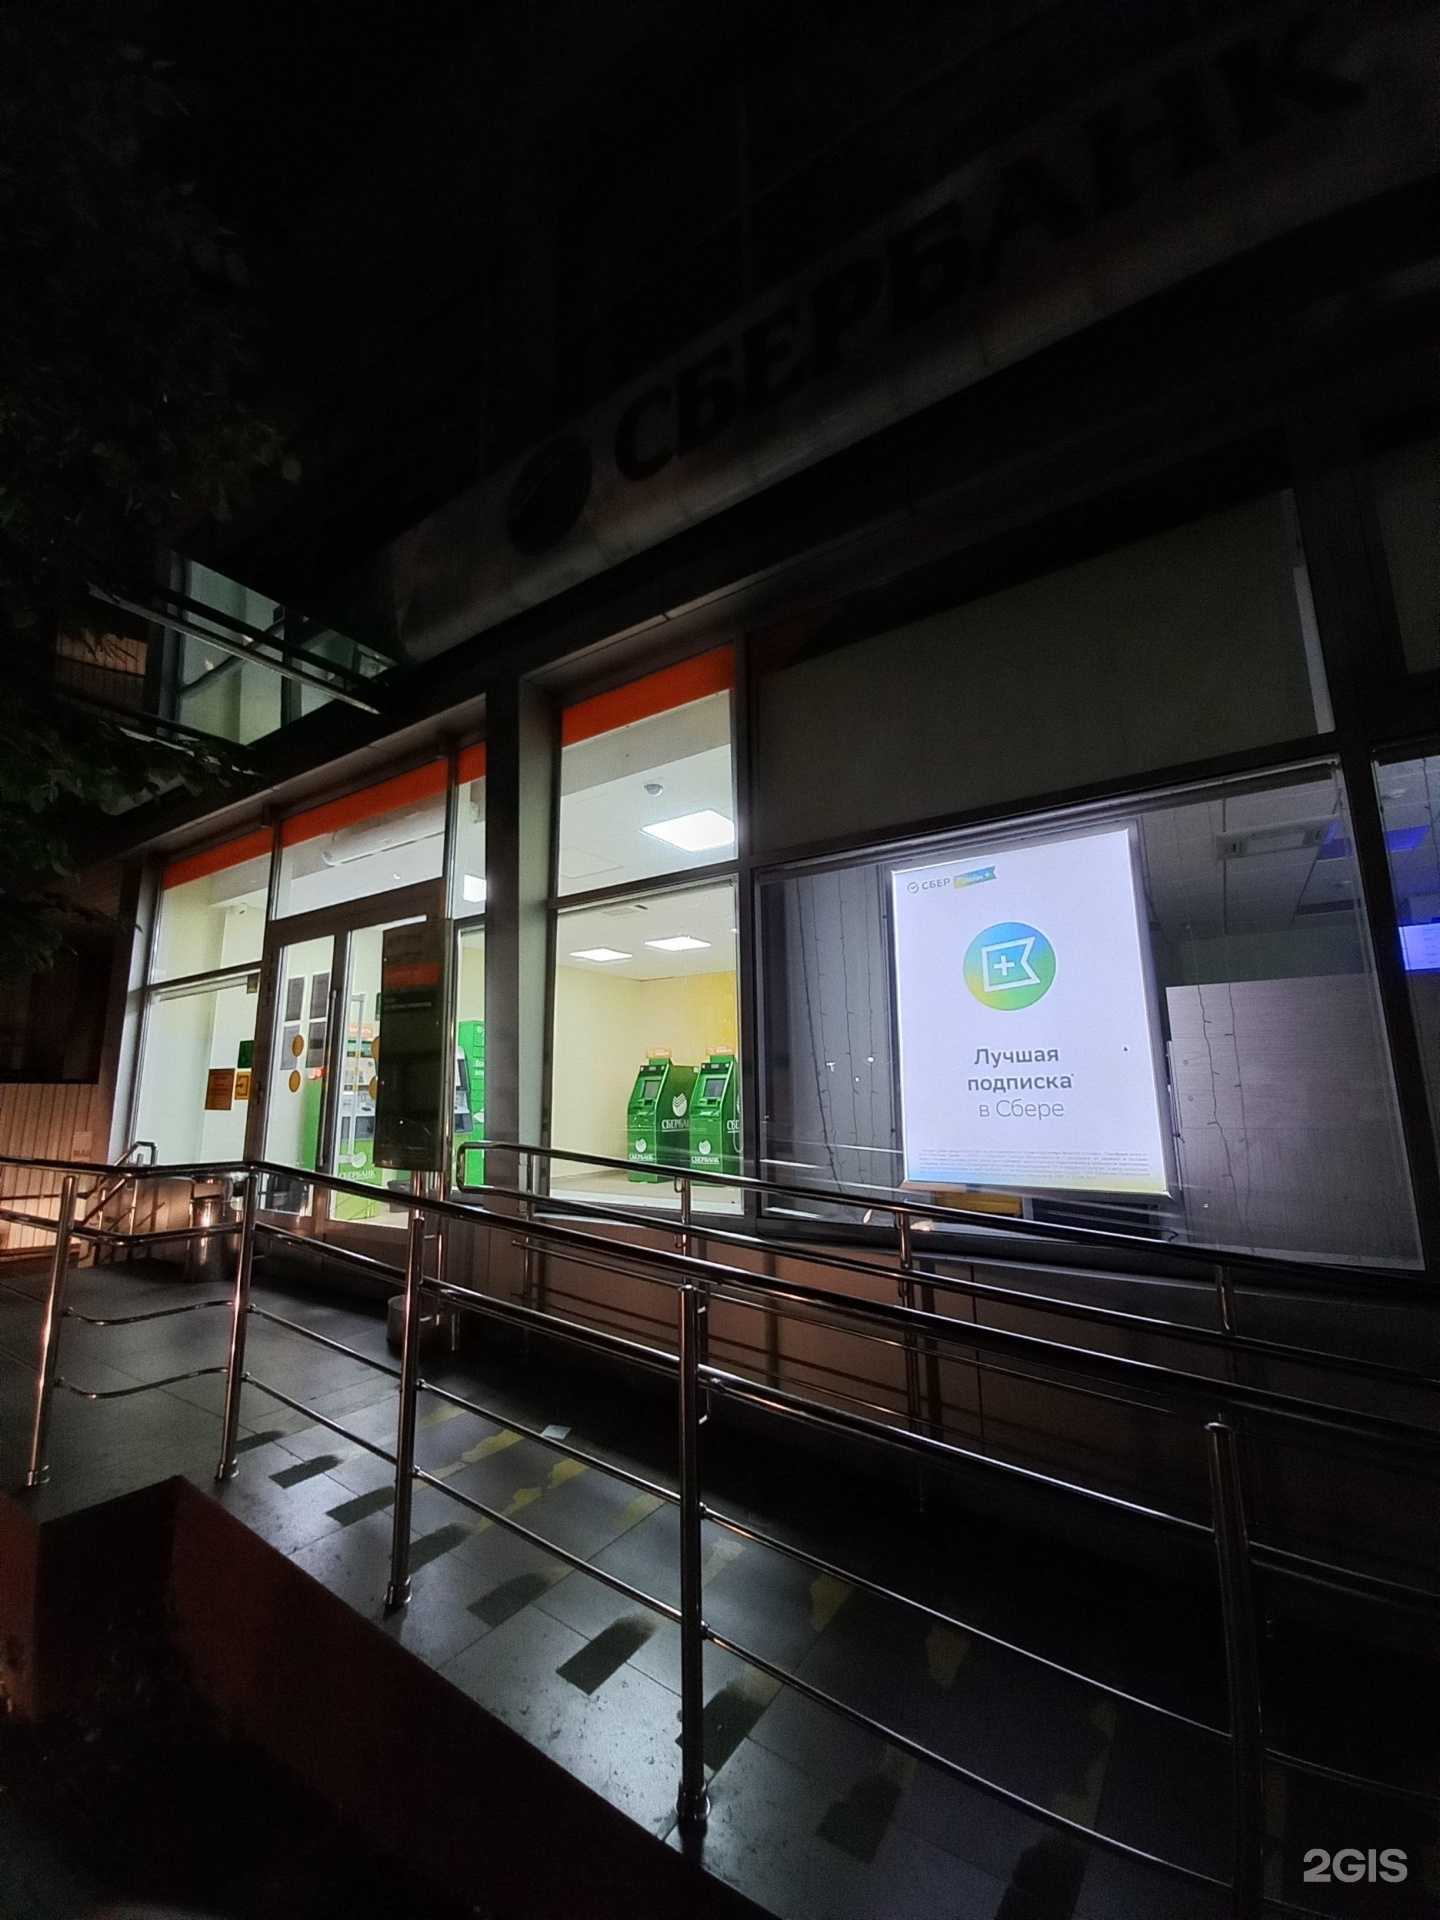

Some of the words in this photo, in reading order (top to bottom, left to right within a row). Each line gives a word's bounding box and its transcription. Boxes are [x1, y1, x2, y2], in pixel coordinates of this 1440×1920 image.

[614, 10, 1367, 482] СБЕРБАНК
[921, 878, 951, 890] СБЕР
[974, 1048, 1059, 1068] Лучшая
[979, 1104, 990, 1117] в
[996, 1098, 1064, 1120] Сбере
